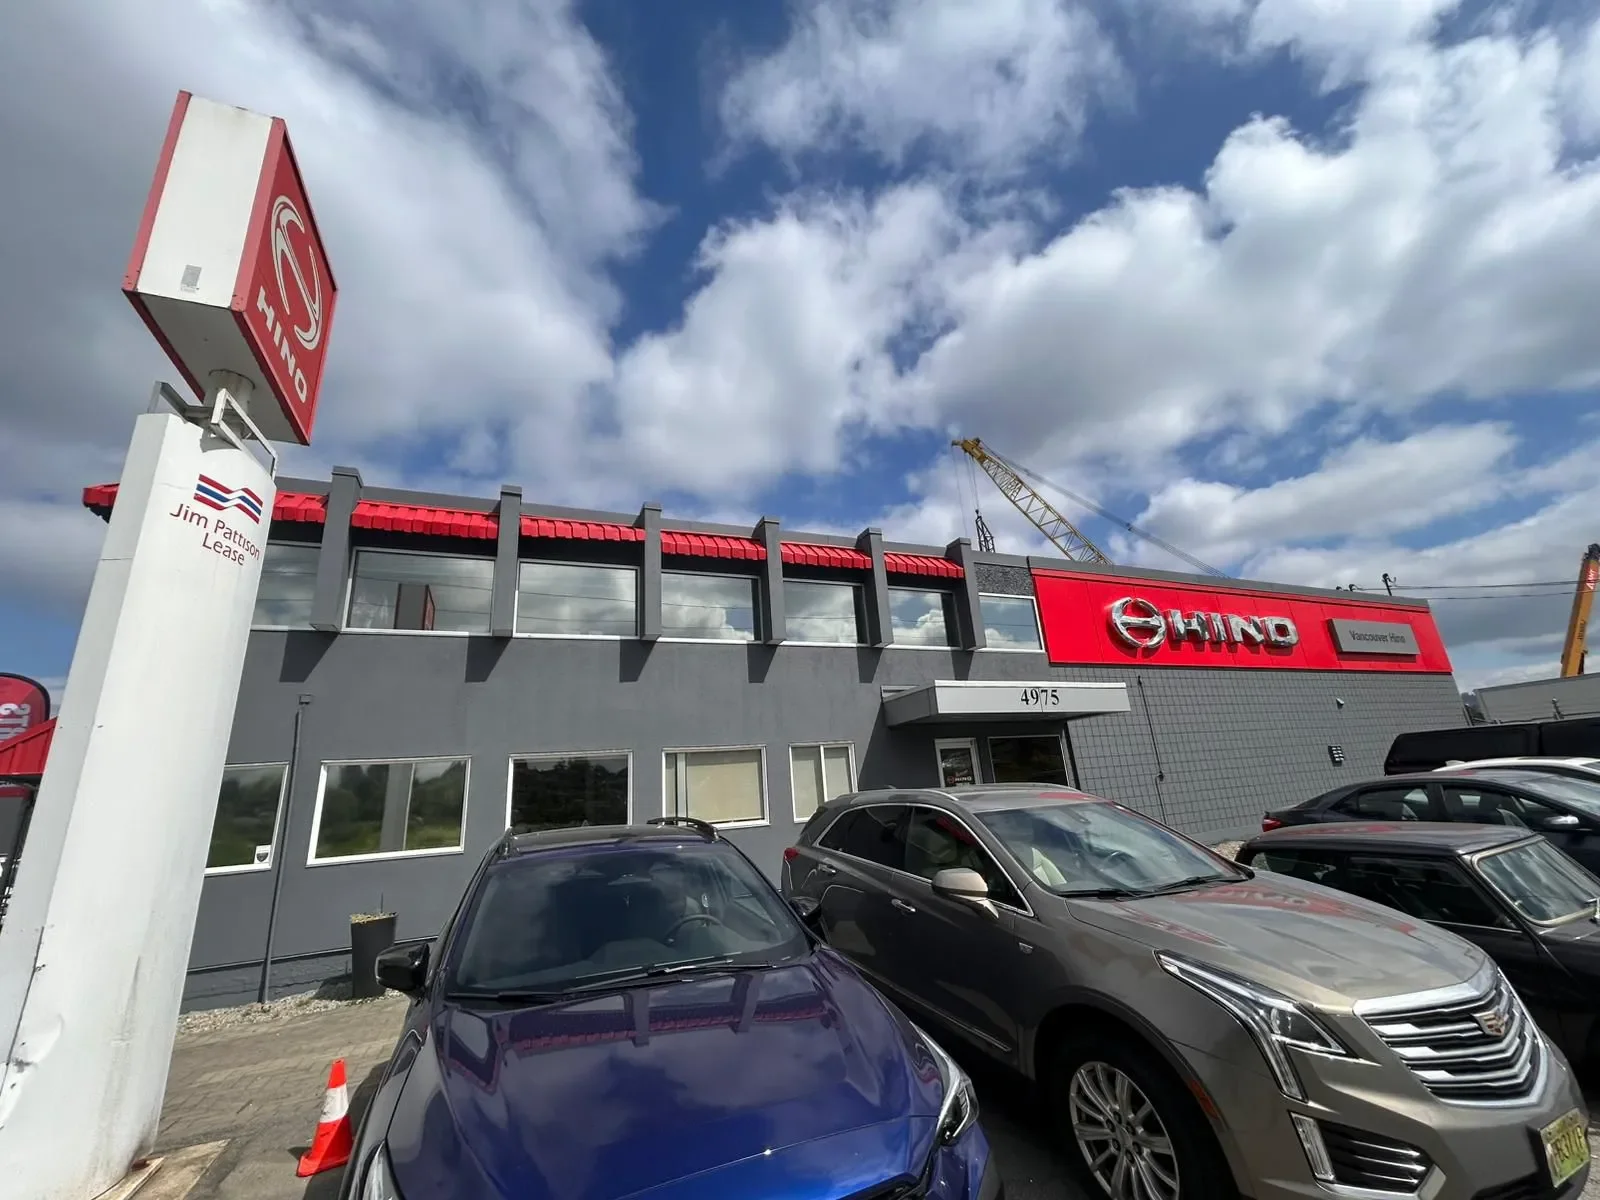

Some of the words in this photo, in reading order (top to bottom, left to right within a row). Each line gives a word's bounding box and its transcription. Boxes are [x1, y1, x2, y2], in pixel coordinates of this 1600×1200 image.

[257, 286, 308, 404] HINO
[169, 504, 208, 529] Jim
[214, 520, 260, 561] Pattison
[202, 532, 245, 566] Lease
[1167, 609, 1299, 647] HINO
[1349, 630, 1388, 642] Vancouver
[1021, 688, 1060, 706] 4975
